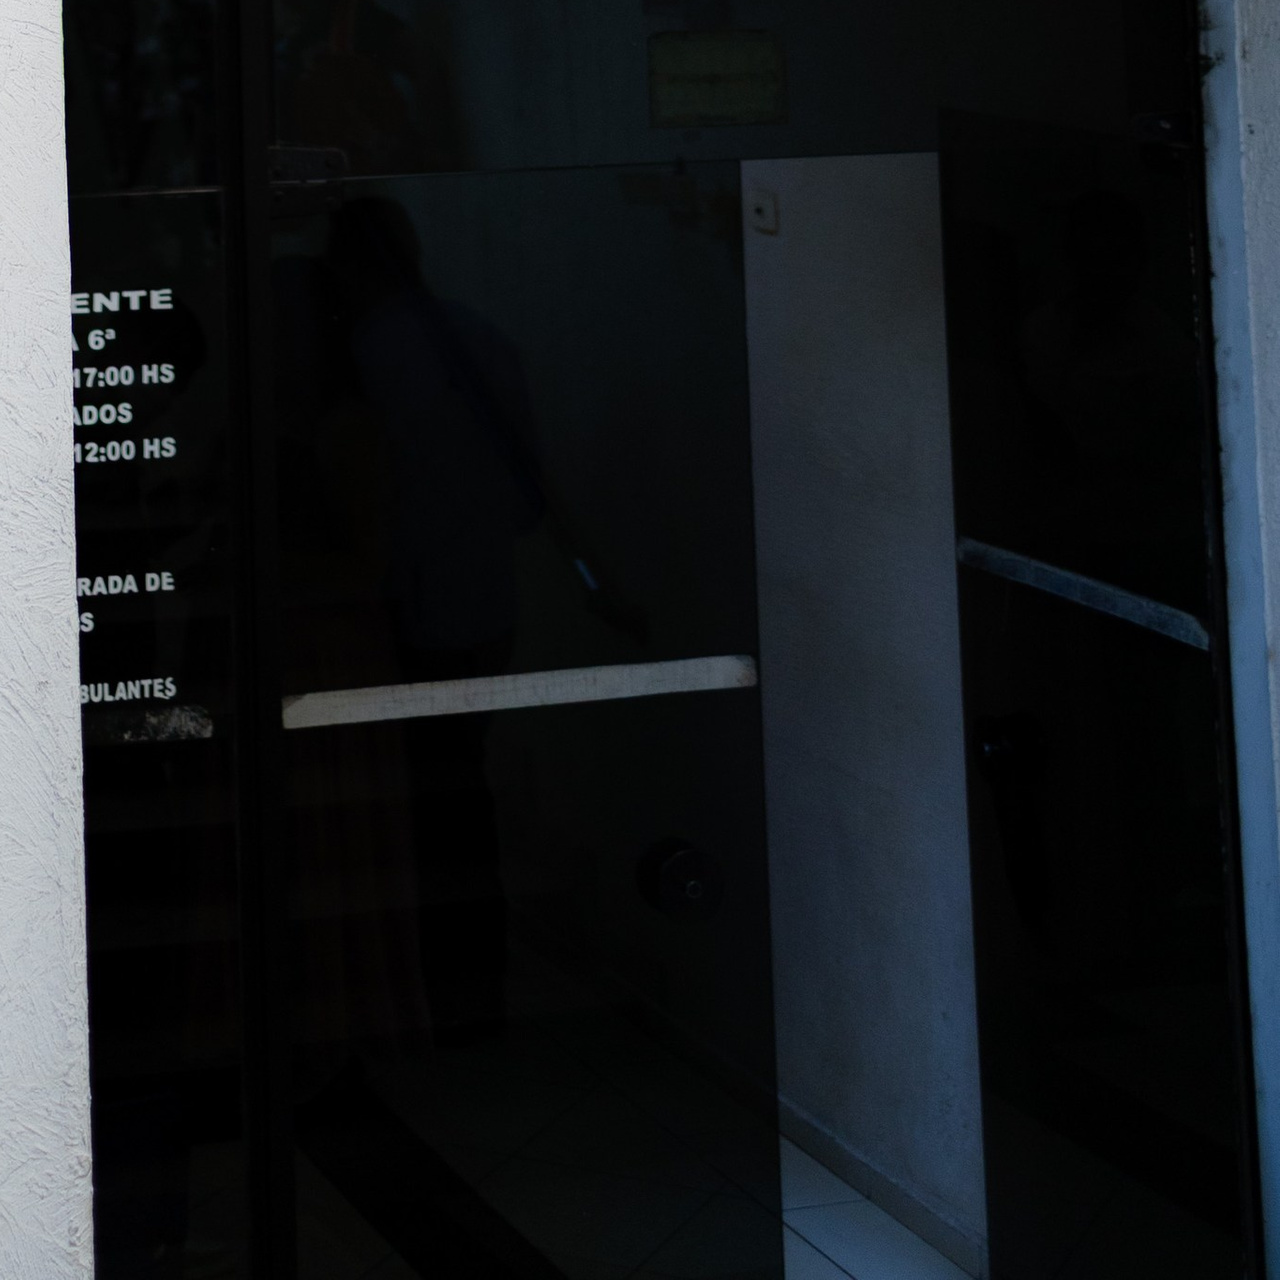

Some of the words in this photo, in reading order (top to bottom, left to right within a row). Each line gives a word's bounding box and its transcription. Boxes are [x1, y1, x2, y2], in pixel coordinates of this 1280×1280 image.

[141, 363, 176, 385] HS
[142, 436, 177, 460] HS
[77, 573, 139, 597] RADA
[145, 570, 176, 592] DE
